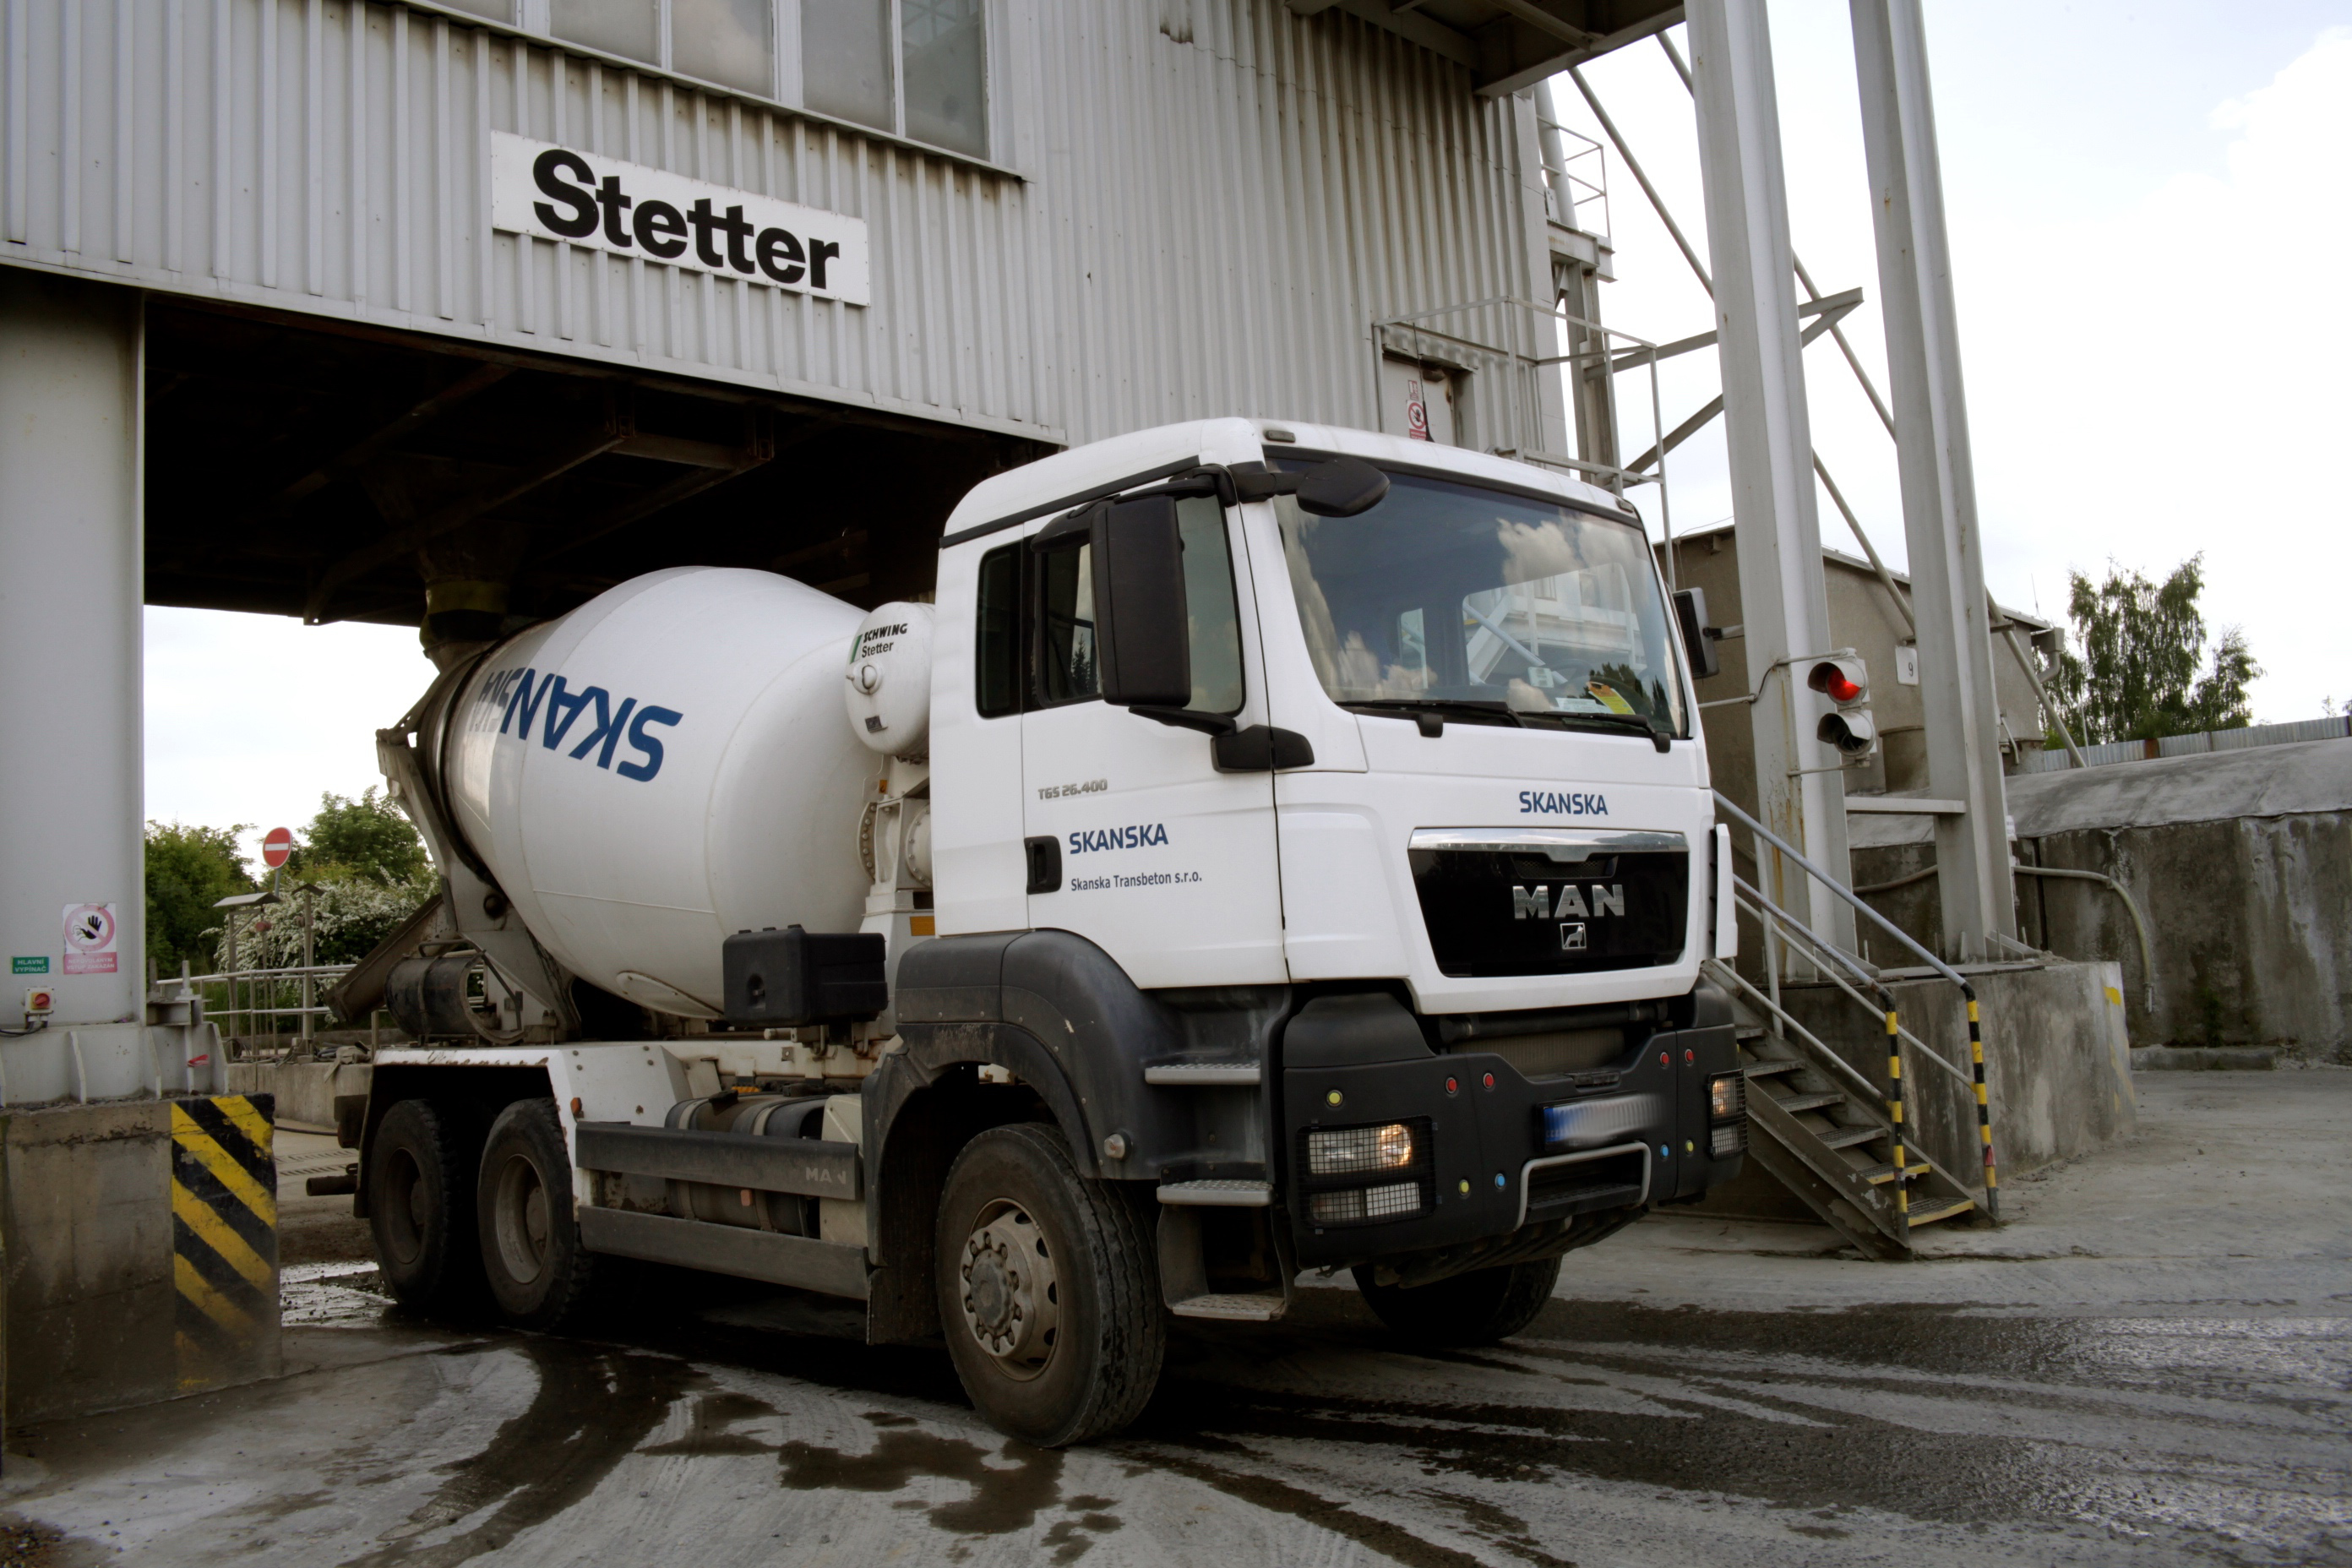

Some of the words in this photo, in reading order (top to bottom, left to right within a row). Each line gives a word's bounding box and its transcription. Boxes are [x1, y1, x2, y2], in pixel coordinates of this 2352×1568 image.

[532, 149, 840, 290] Stetter
[863, 623, 908, 644] SCHWING
[862, 642, 894, 658] Stetter
[1908, 662, 1914, 677] 9
[1037, 786, 1060, 800] TGS
[1061, 778, 1108, 797] 26.400
[1519, 791, 1609, 815] SKANSKA
[1069, 823, 1169, 855] SKANSKA
[1070, 876, 1111, 891] Skanska
[1113, 872, 1172, 888] Transbeton
[1174, 871, 1202, 884] s.r.o.
[1512, 885, 1625, 920] MAN
